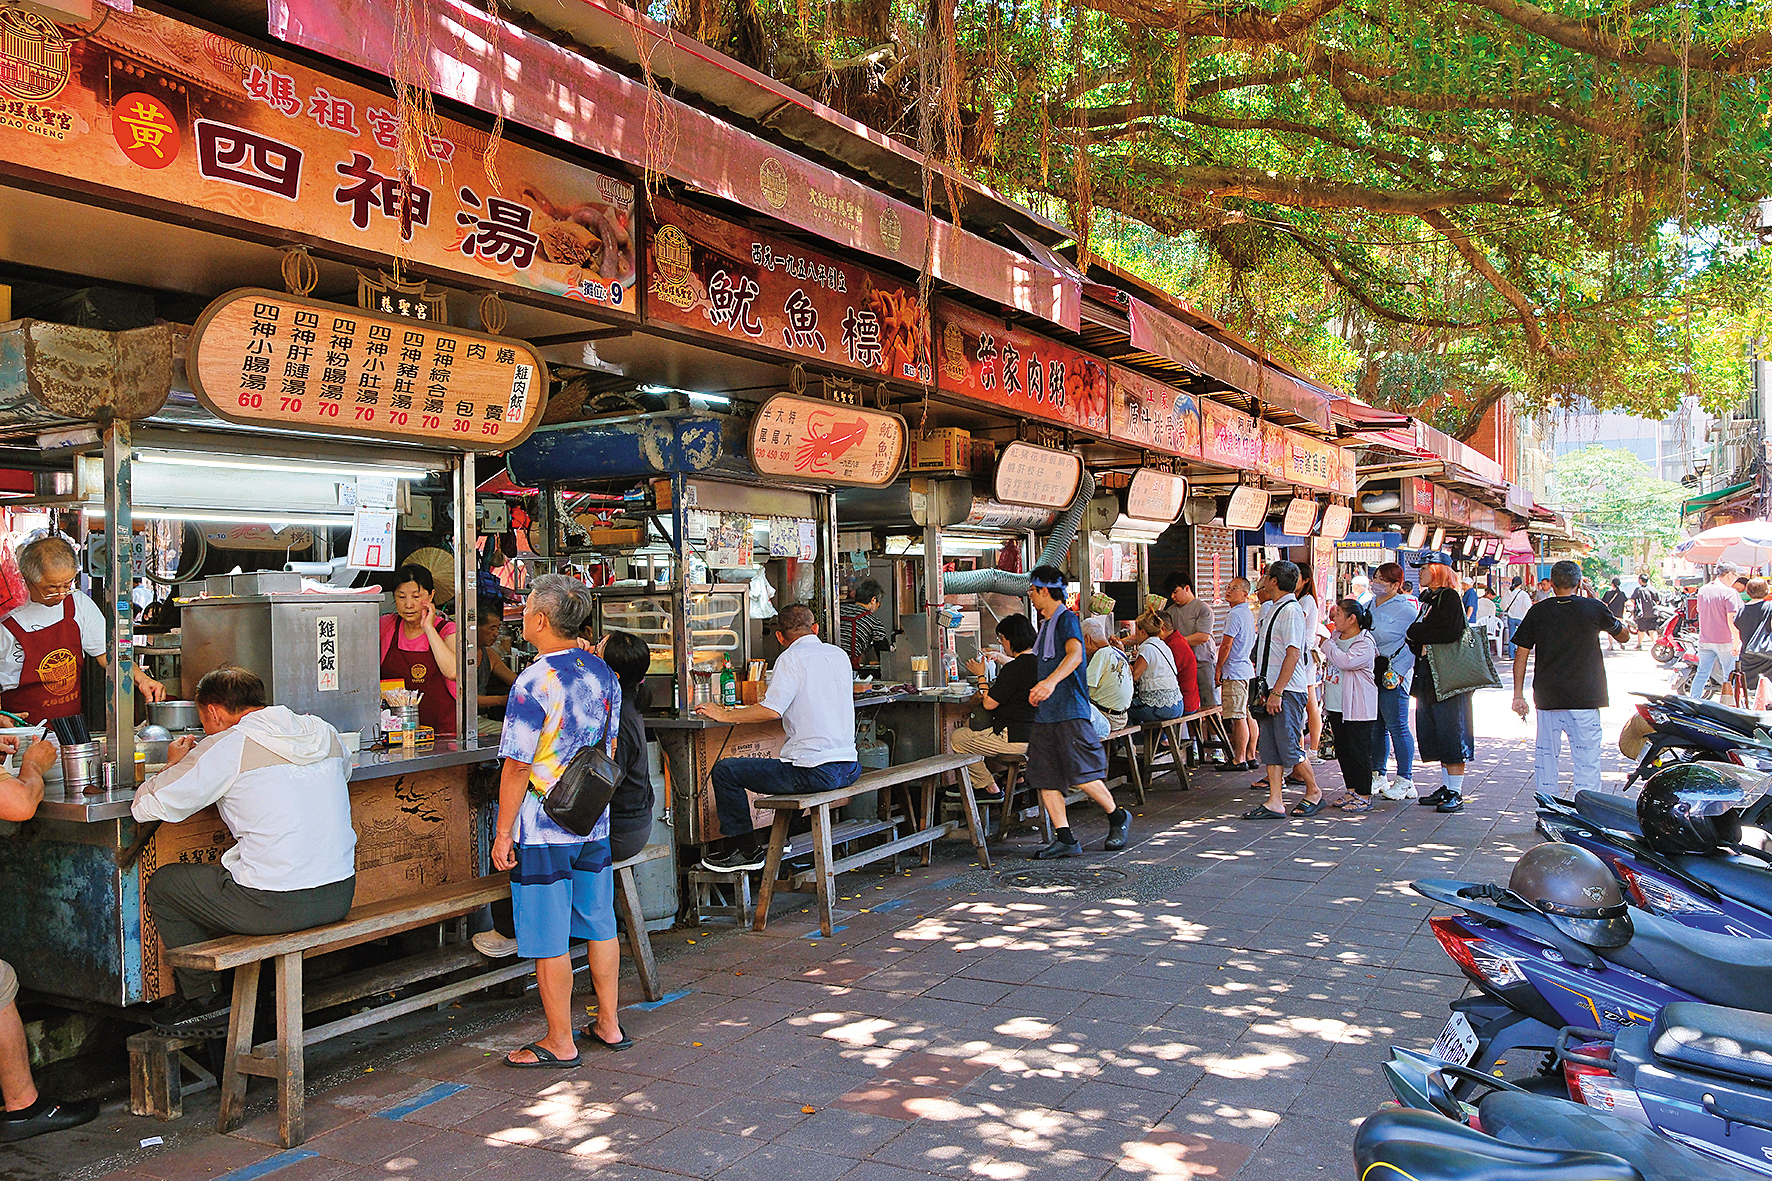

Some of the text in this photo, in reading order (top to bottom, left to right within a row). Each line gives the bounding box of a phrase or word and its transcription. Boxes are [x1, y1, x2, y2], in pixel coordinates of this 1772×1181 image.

[118, 101, 172, 159] 黃
[243, 65, 455, 162] 媽祖宮口
[27, 123, 64, 140] CHENG
[195, 118, 540, 269] 四神湯
[381, 296, 428, 320] 慈聖宮
[708, 269, 883, 368] 魷魚標
[239, 303, 280, 391] 四神小腸湯
[319, 318, 356, 401] 四神粉腸湯
[355, 325, 391, 405] 四神小肚湯
[391, 331, 425, 410] 四神豬肚湯
[422, 337, 457, 414] 四神綜合湯
[976, 332, 1066, 409] 葉家肉粥
[238, 392, 262, 409] 60
[509, 365, 529, 409] 雞肉飯
[279, 396, 302, 413] 70
[318, 402, 340, 418] 70
[354, 406, 375, 422] 70
[388, 410, 409, 426] 70
[507, 408, 522, 421] 40
[421, 415, 440, 429] 70
[452, 418, 470, 433] 30
[481, 422, 500, 436] 50
[1128, 402, 1186, 452] 原汁排骨湯
[766, 449, 778, 460] 450
[317, 619, 337, 672] 雞肉飯
[319, 672, 338, 690] 40
